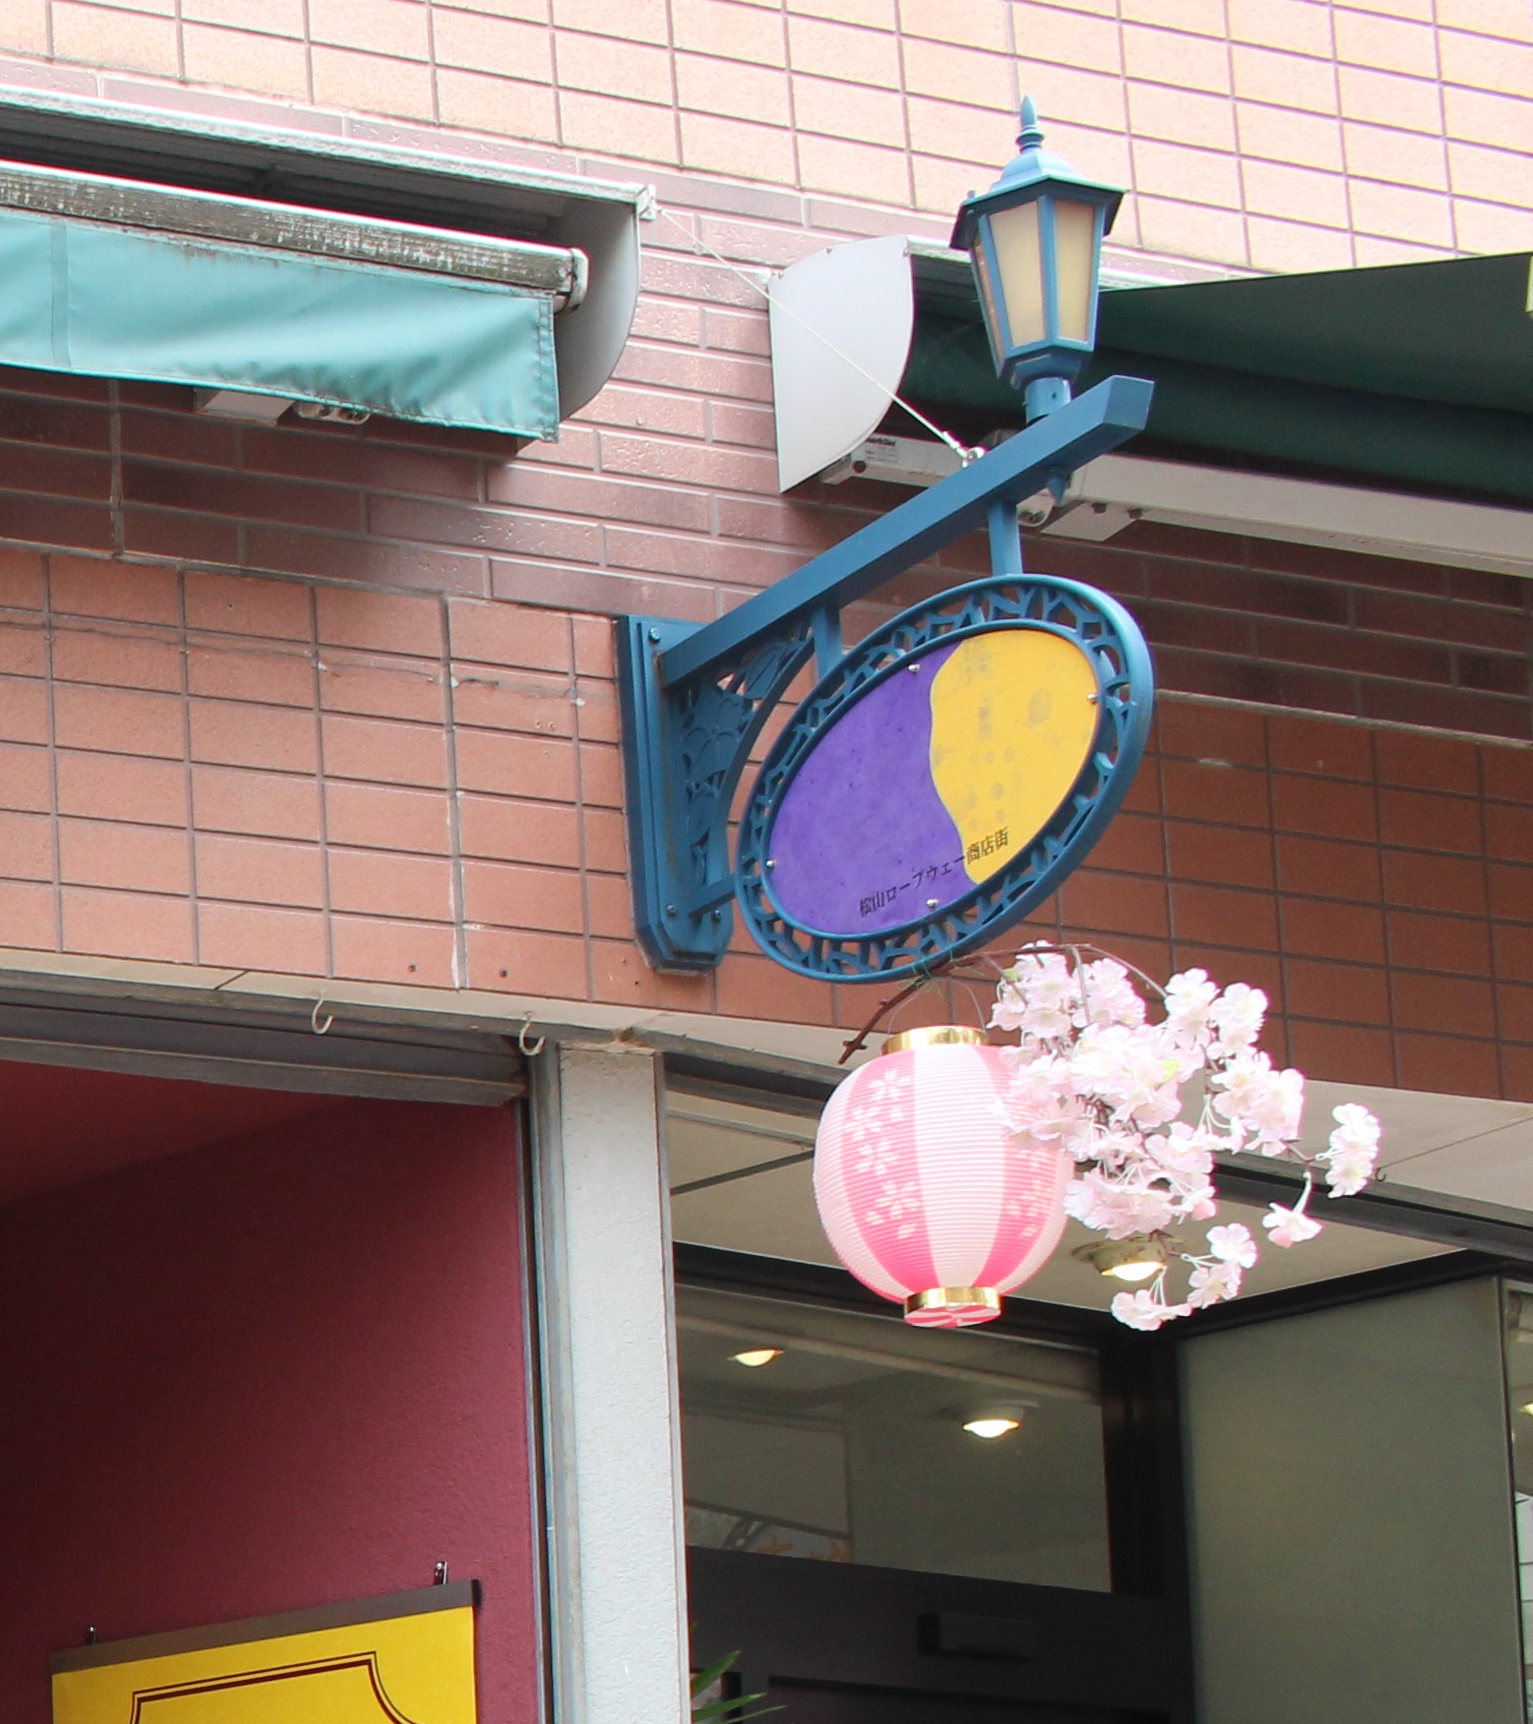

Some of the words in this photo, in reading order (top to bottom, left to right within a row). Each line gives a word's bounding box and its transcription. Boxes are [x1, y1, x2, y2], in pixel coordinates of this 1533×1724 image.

[859, 827, 1009, 918] 松山ロープウェー商店街
